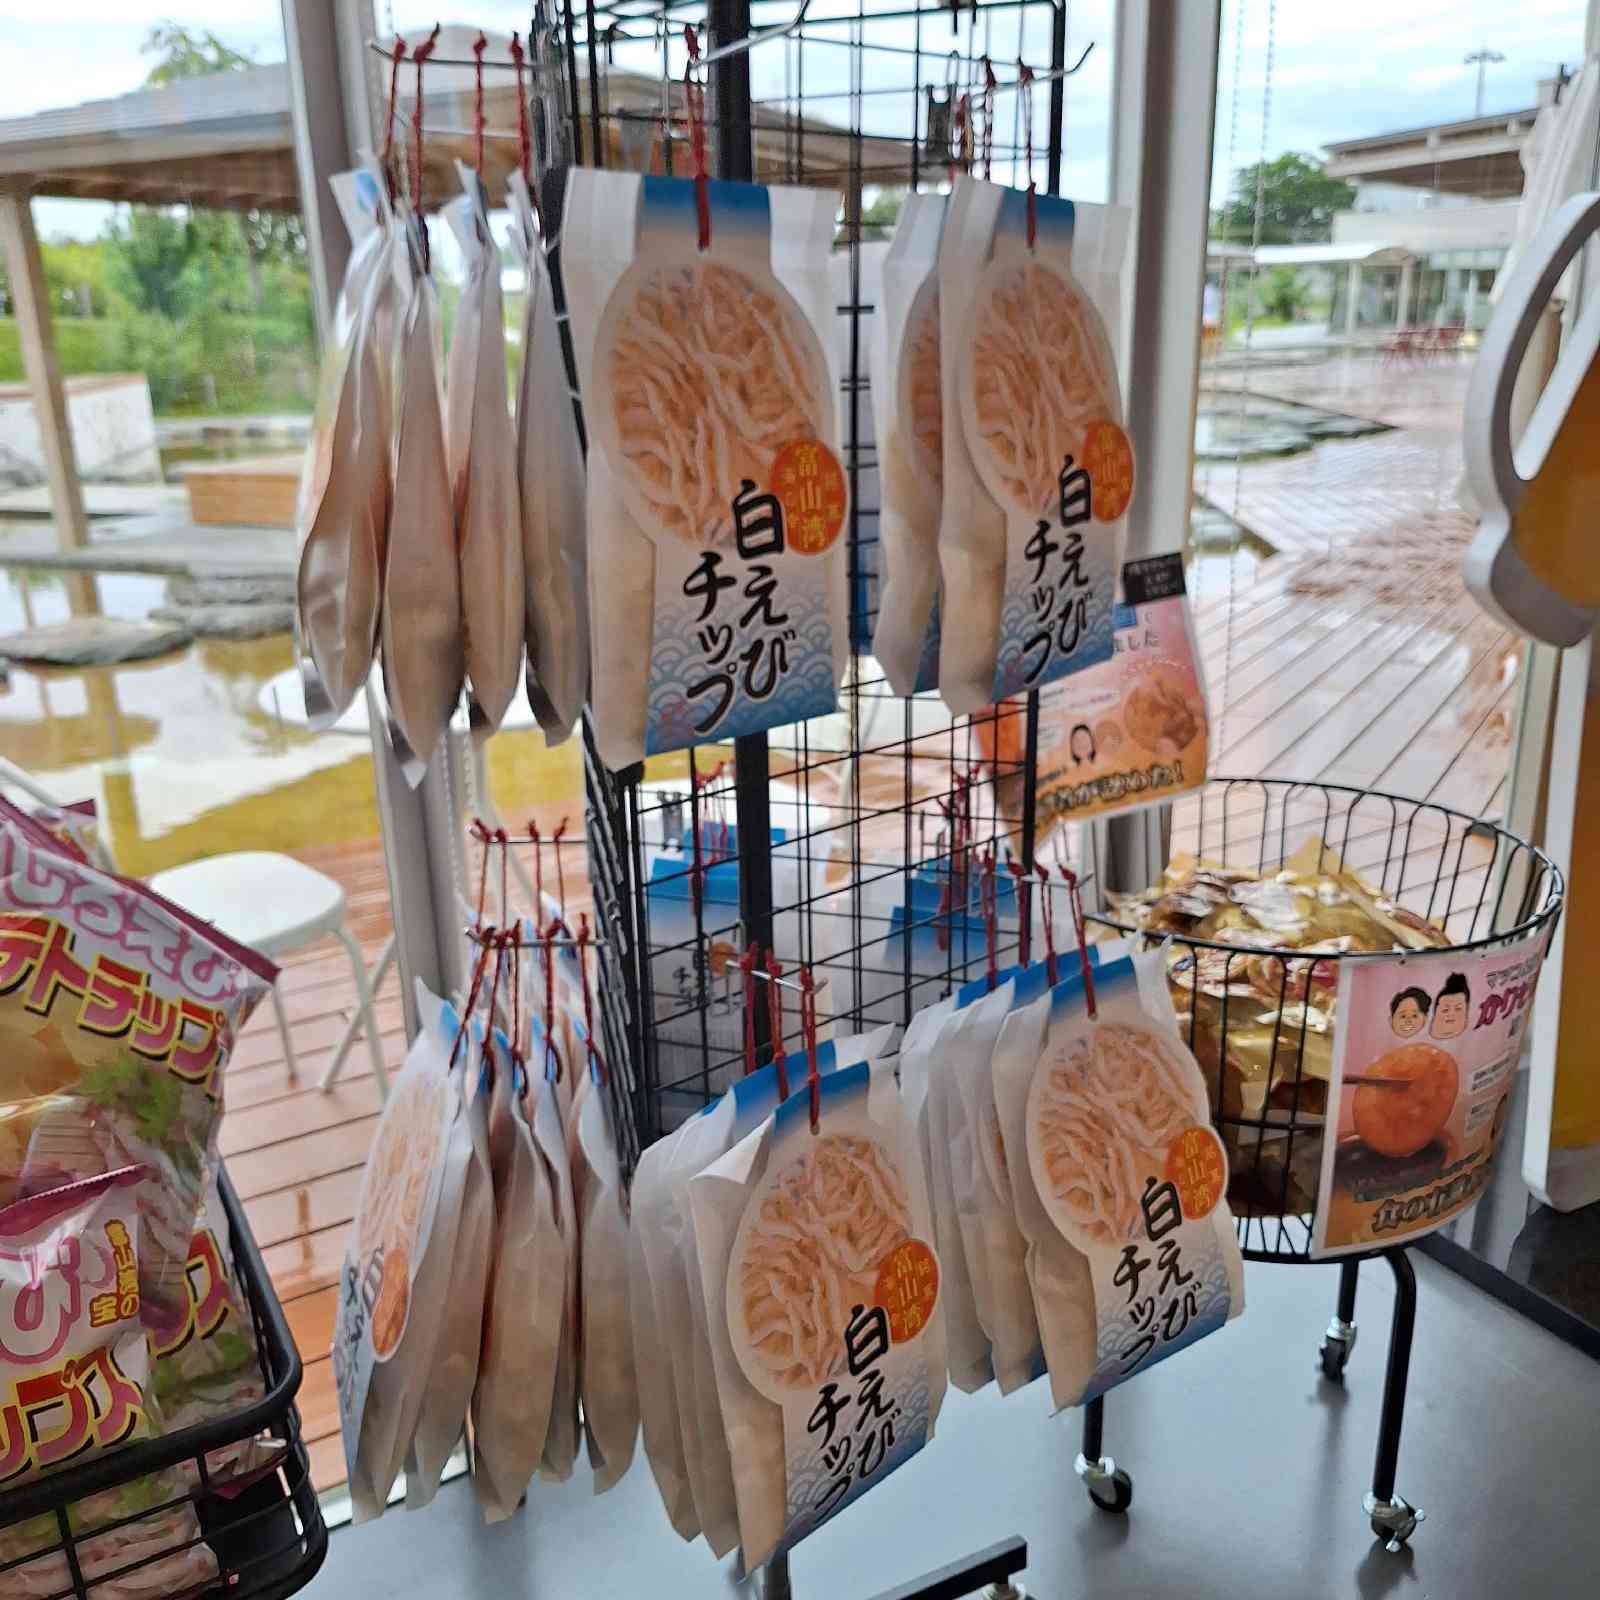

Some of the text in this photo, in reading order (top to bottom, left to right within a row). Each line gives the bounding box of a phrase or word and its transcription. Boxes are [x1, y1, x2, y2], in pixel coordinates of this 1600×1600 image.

[731, 478, 797, 700] 白えび
[1022, 519, 1060, 685] チップ
[1058, 454, 1094, 652] 白えび
[683, 551, 738, 734] チップ
[1113, 1244, 1160, 1376] チップ
[1141, 1176, 1202, 1342] 白えび
[807, 1382, 853, 1518] チップ
[844, 1304, 902, 1479] 白えび
